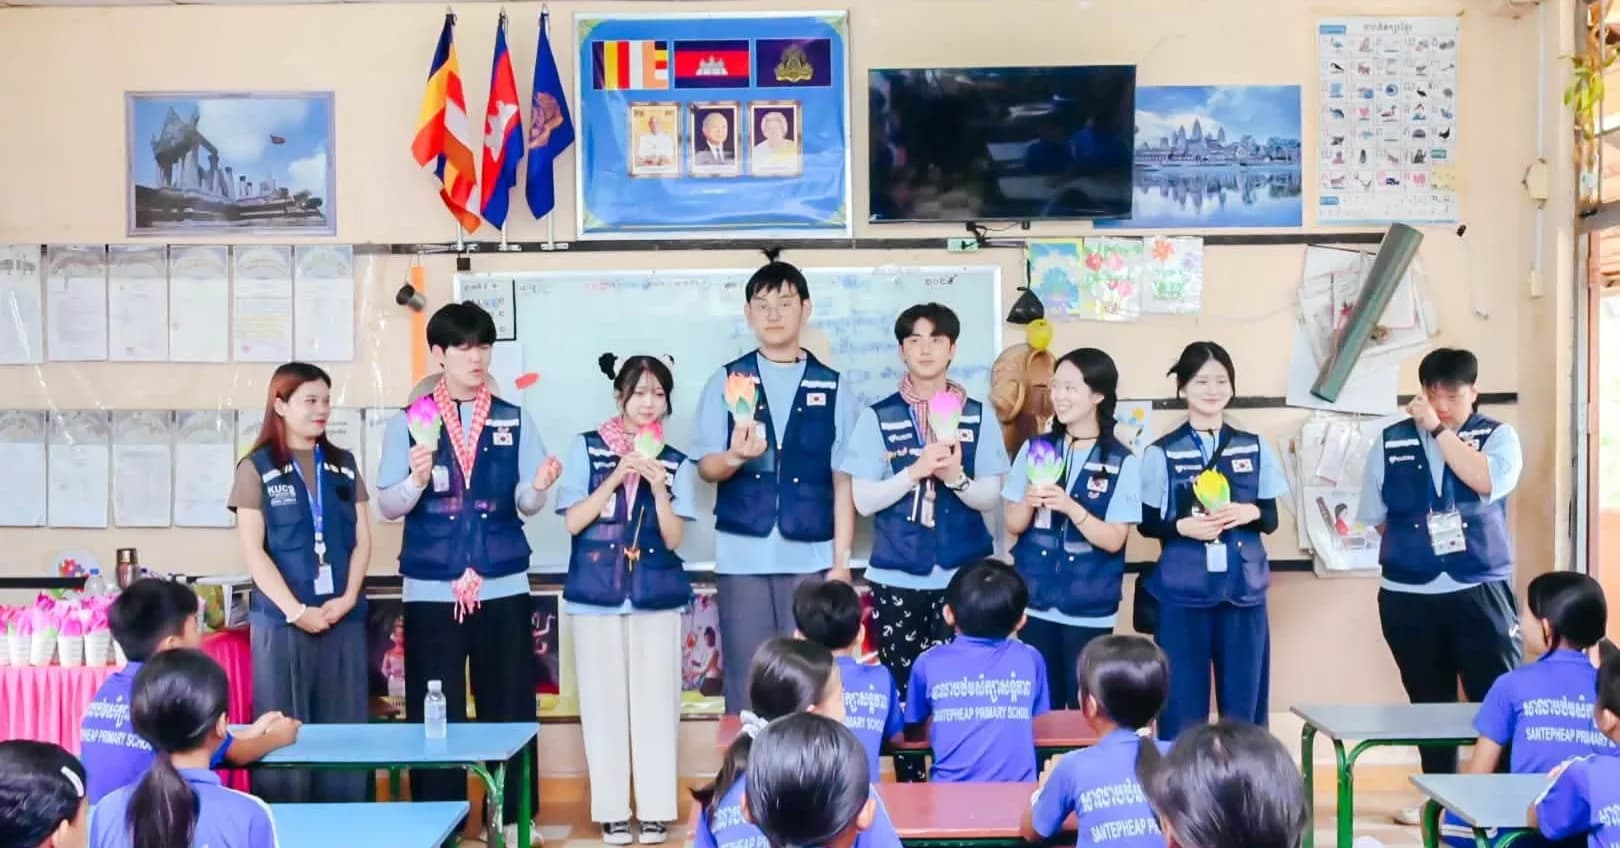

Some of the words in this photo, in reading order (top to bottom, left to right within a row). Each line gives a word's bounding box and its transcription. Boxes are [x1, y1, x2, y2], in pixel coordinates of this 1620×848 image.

[976, 706, 1006, 719] PRIMARY
[1526, 726, 1575, 742] SANTEPHEAP
[1091, 818, 1146, 843] SANTEPHEAP
